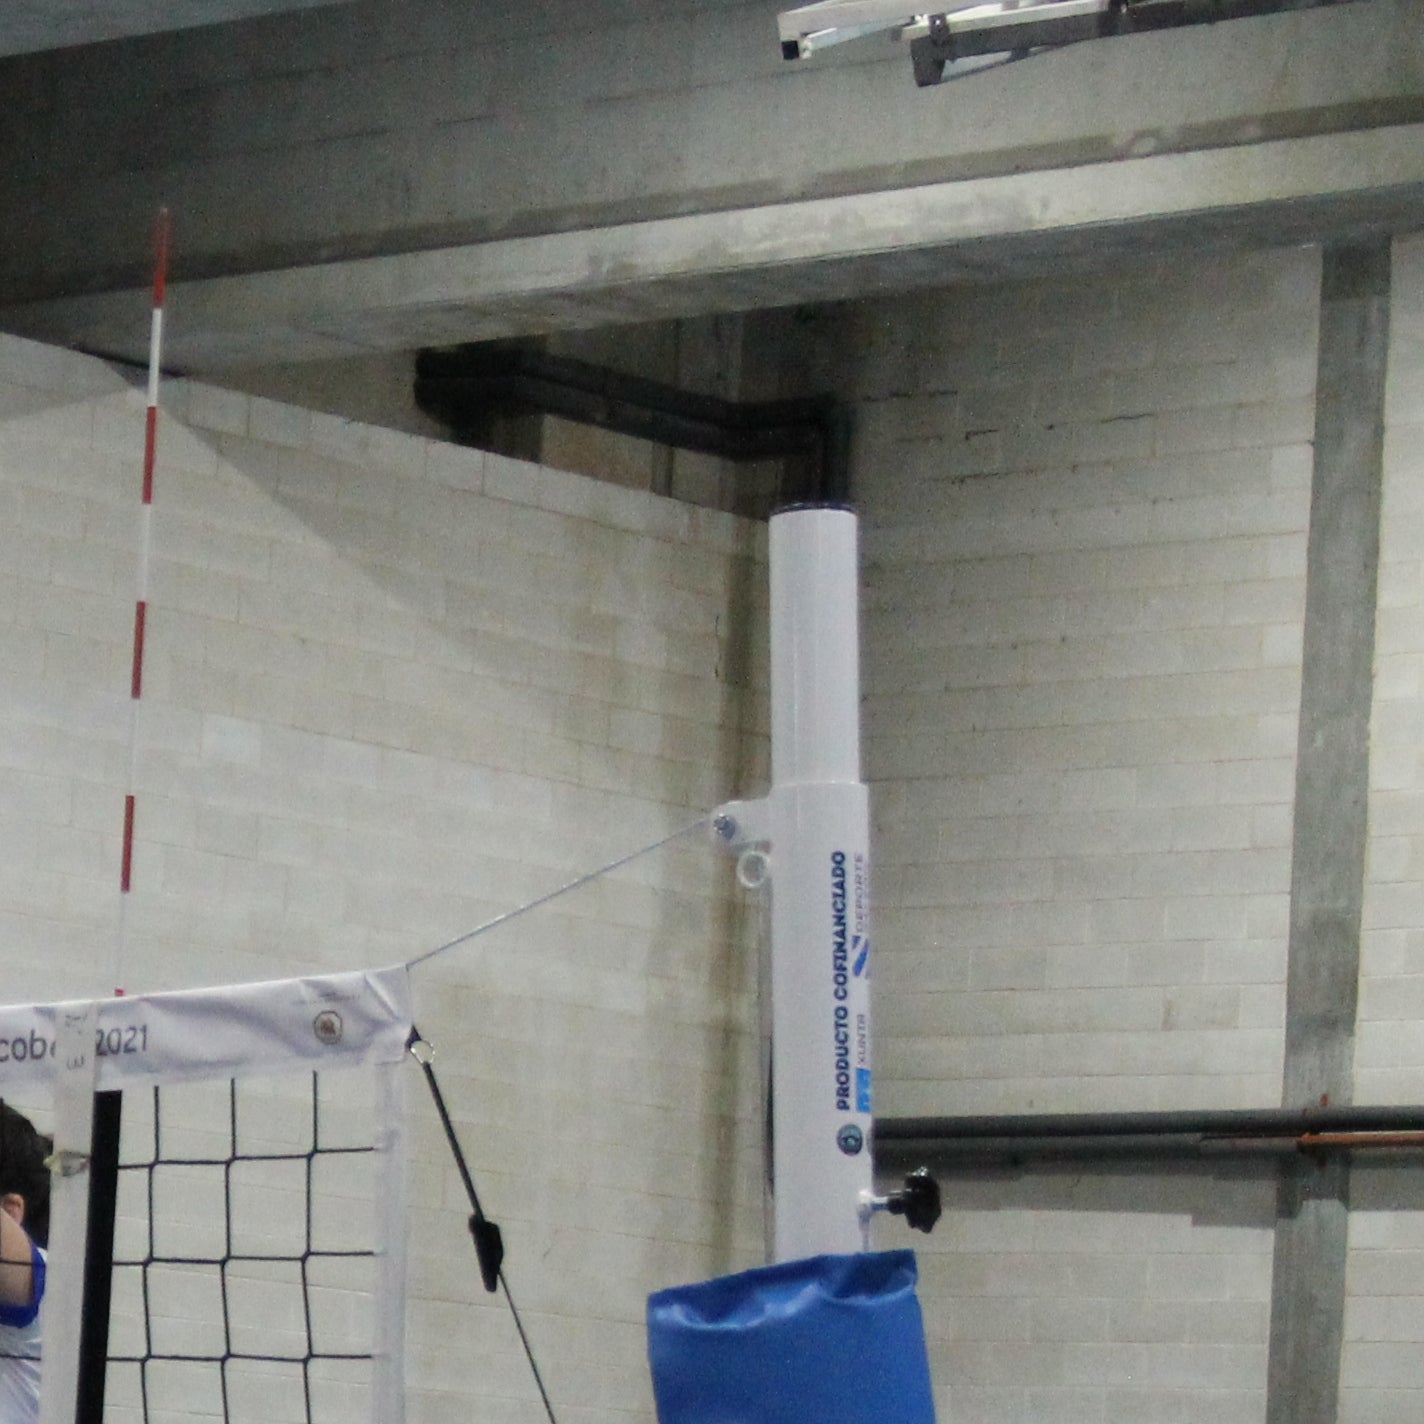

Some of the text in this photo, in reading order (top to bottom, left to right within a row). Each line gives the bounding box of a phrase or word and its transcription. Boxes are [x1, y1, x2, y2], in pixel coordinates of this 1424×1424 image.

[95, 1023, 147, 1056] 2021
[831, 851, 850, 1111] PRODUCTO COFINANCIADO
